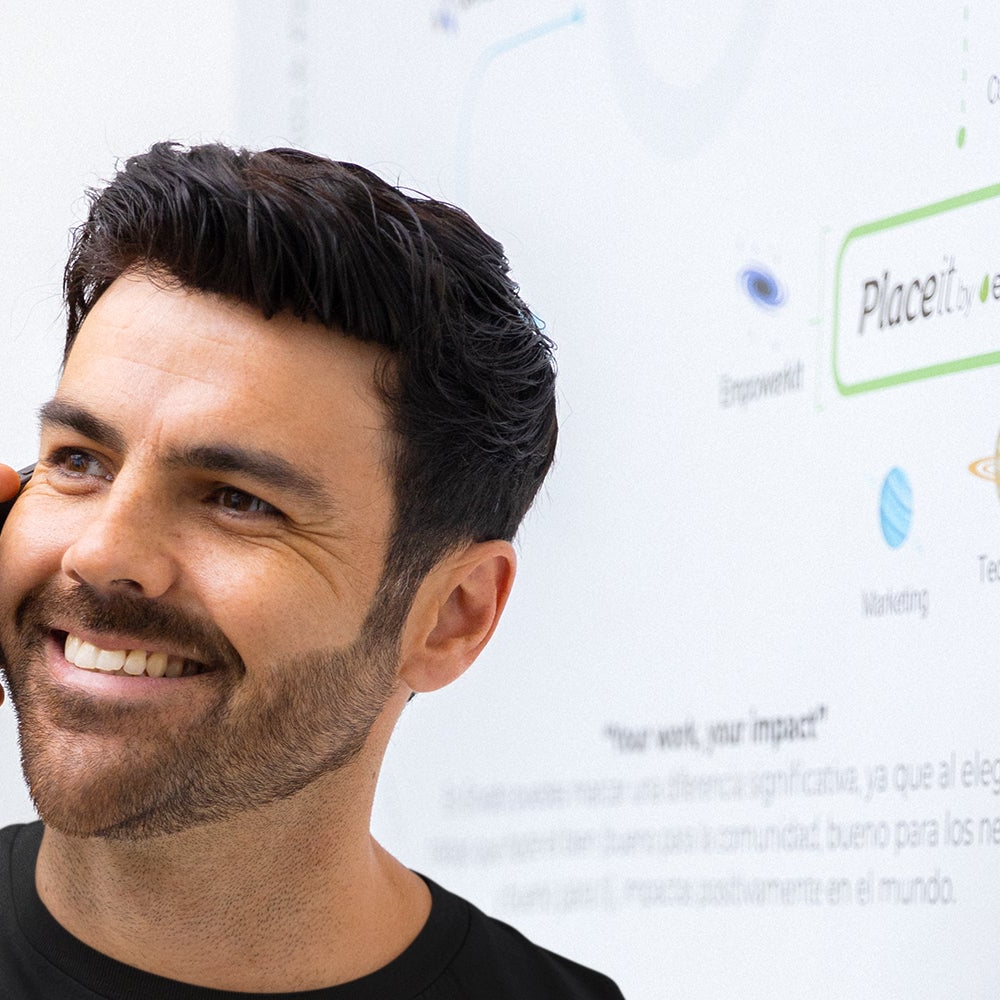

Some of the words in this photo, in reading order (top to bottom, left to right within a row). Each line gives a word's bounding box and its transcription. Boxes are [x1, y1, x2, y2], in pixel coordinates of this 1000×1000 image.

[857, 254, 957, 335] Placeit
[861, 587, 929, 620] Marketing
[863, 764, 888, 803] ya
[892, 762, 934, 801] que
[936, 750, 956, 791] al
[826, 817, 890, 851] bueno
[893, 818, 939, 856] para
[943, 810, 974, 848] los
[825, 877, 852, 906] en
[854, 868, 875, 906] el
[877, 867, 957, 906] mundo.
